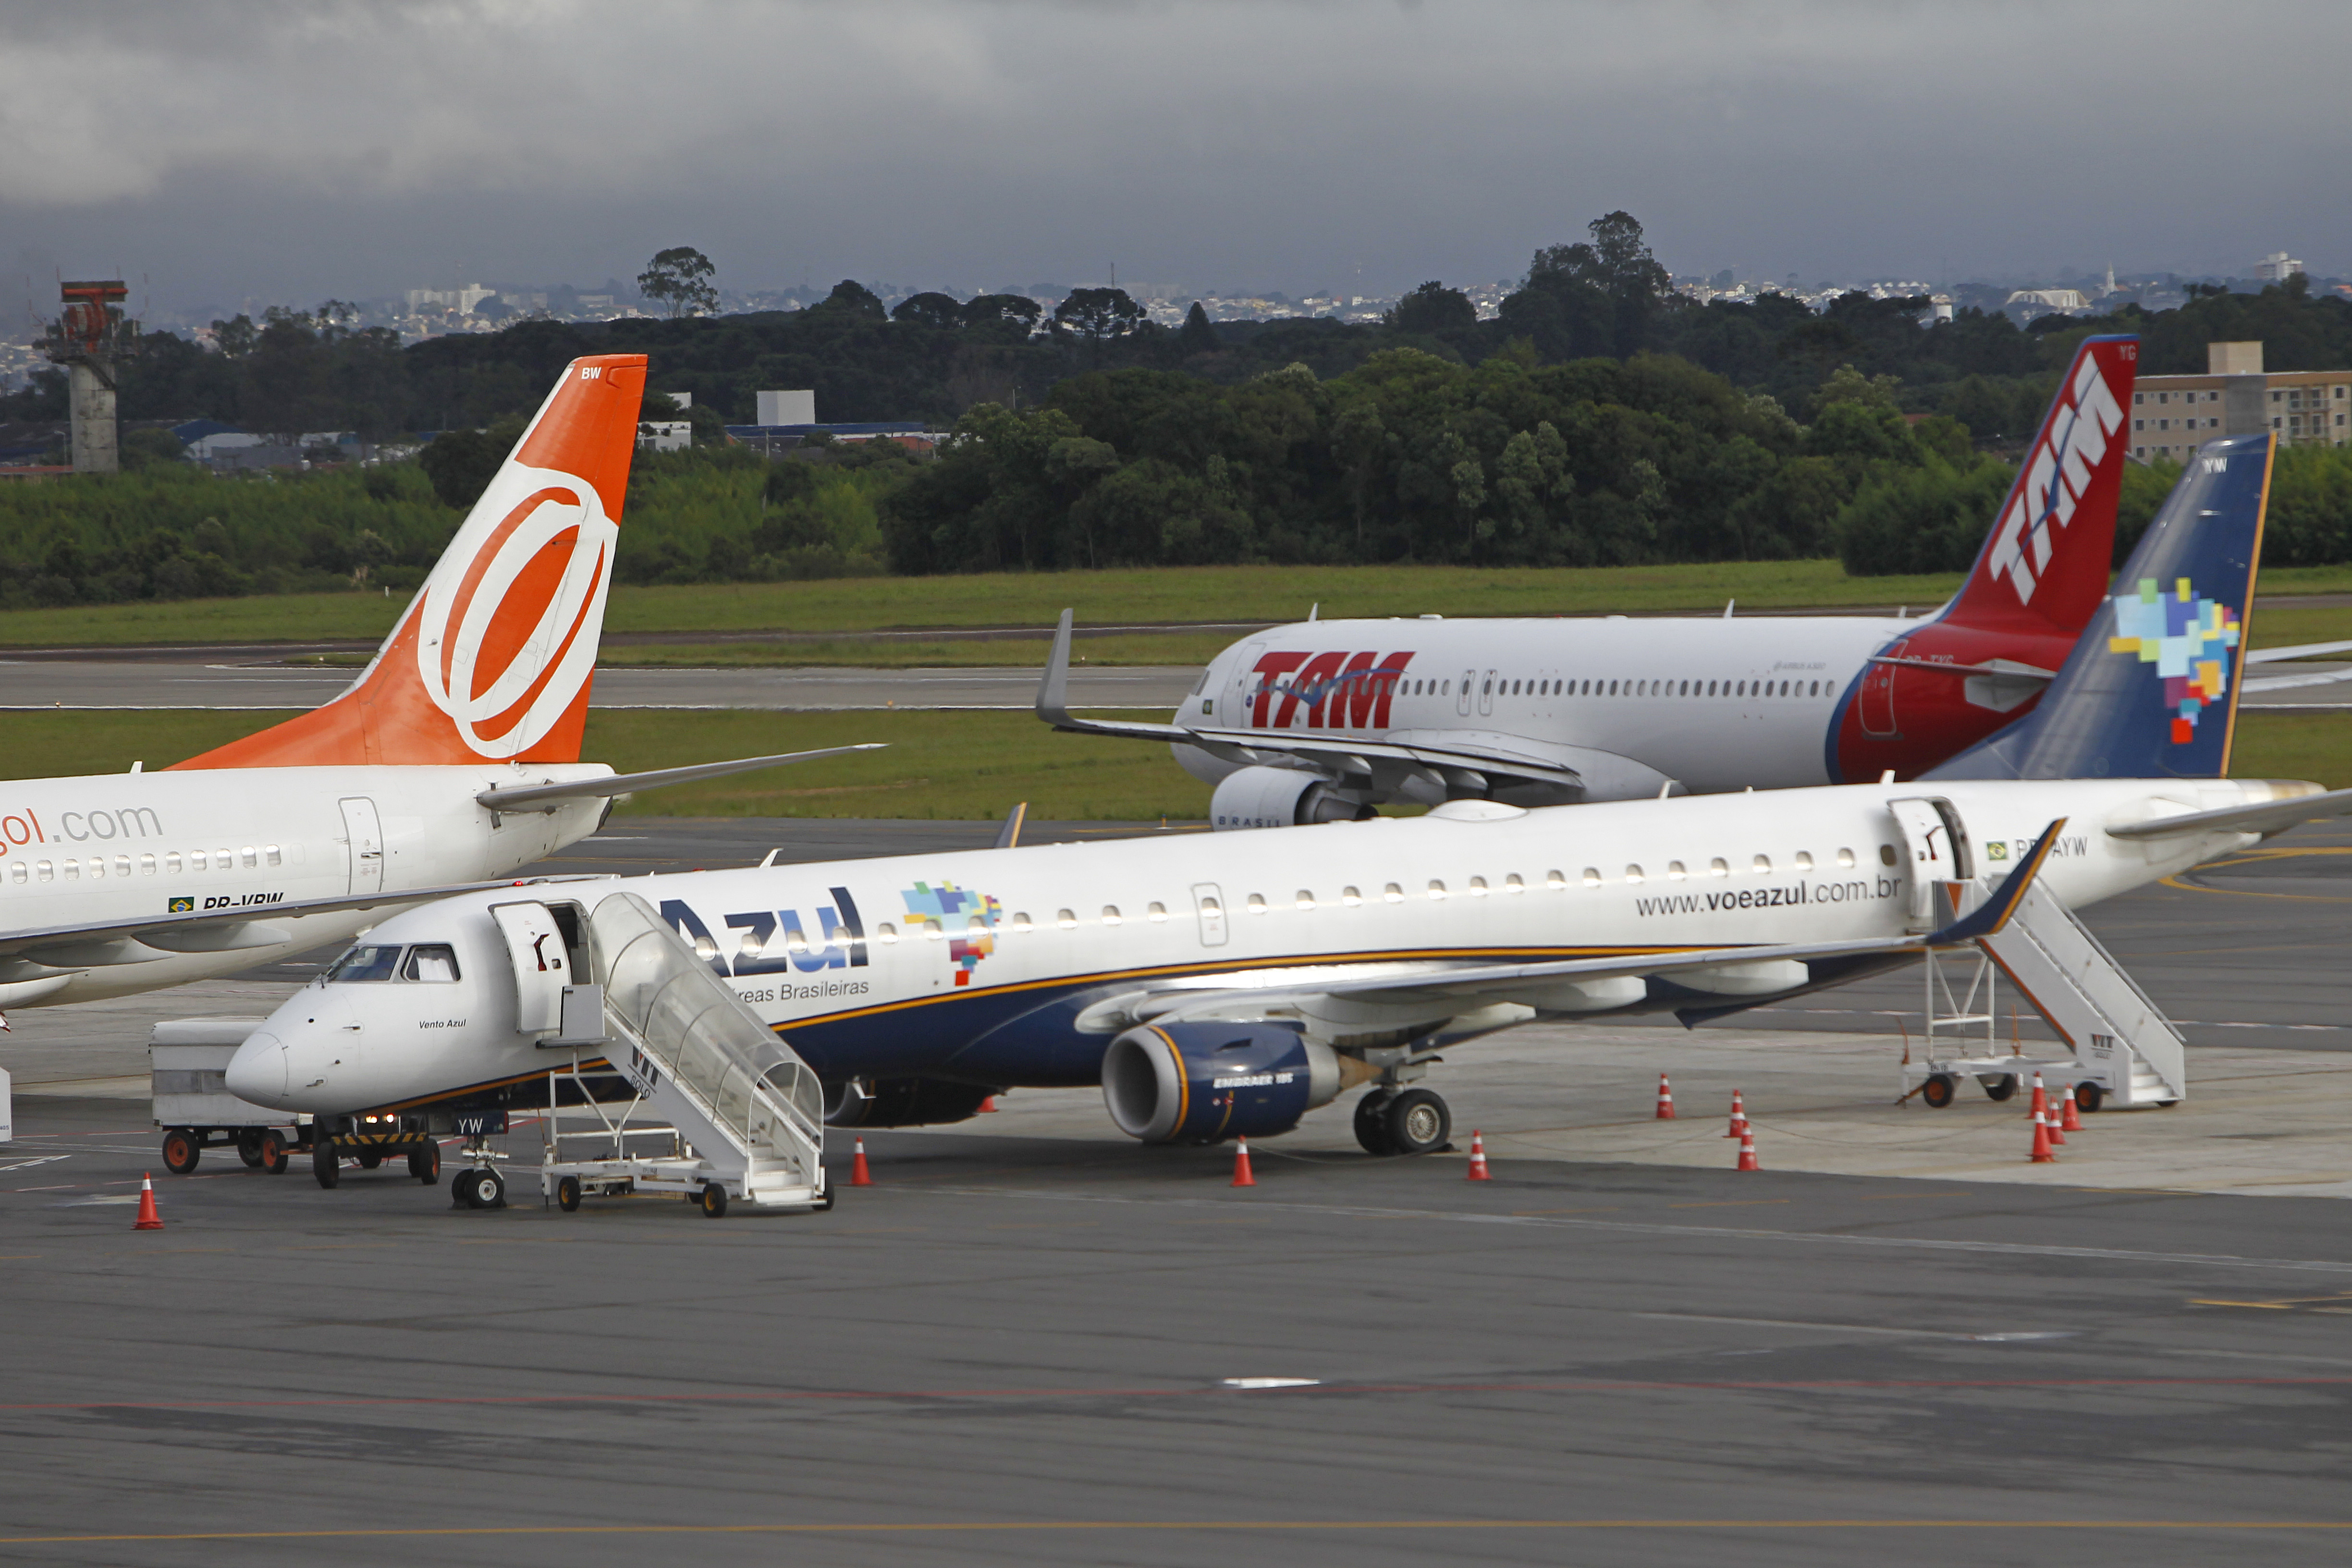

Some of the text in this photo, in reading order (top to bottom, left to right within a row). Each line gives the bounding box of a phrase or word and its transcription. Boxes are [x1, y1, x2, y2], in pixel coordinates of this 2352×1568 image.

[2120, 345, 2136, 360] YG
[581, 367, 601, 380] BW
[2202, 457, 2228, 475] YW
[1990, 350, 2124, 606] TAM
[1252, 651, 1416, 728] TAM
[0, 807, 163, 857] ol.com
[1636, 873, 1902, 917] www.voeazul.com.br
[659, 886, 870, 977] Azul
[732, 980, 870, 1003] reas Brasileiras
[419, 1018, 466, 1029] Vento Azul
[458, 1118, 483, 1134] YW
